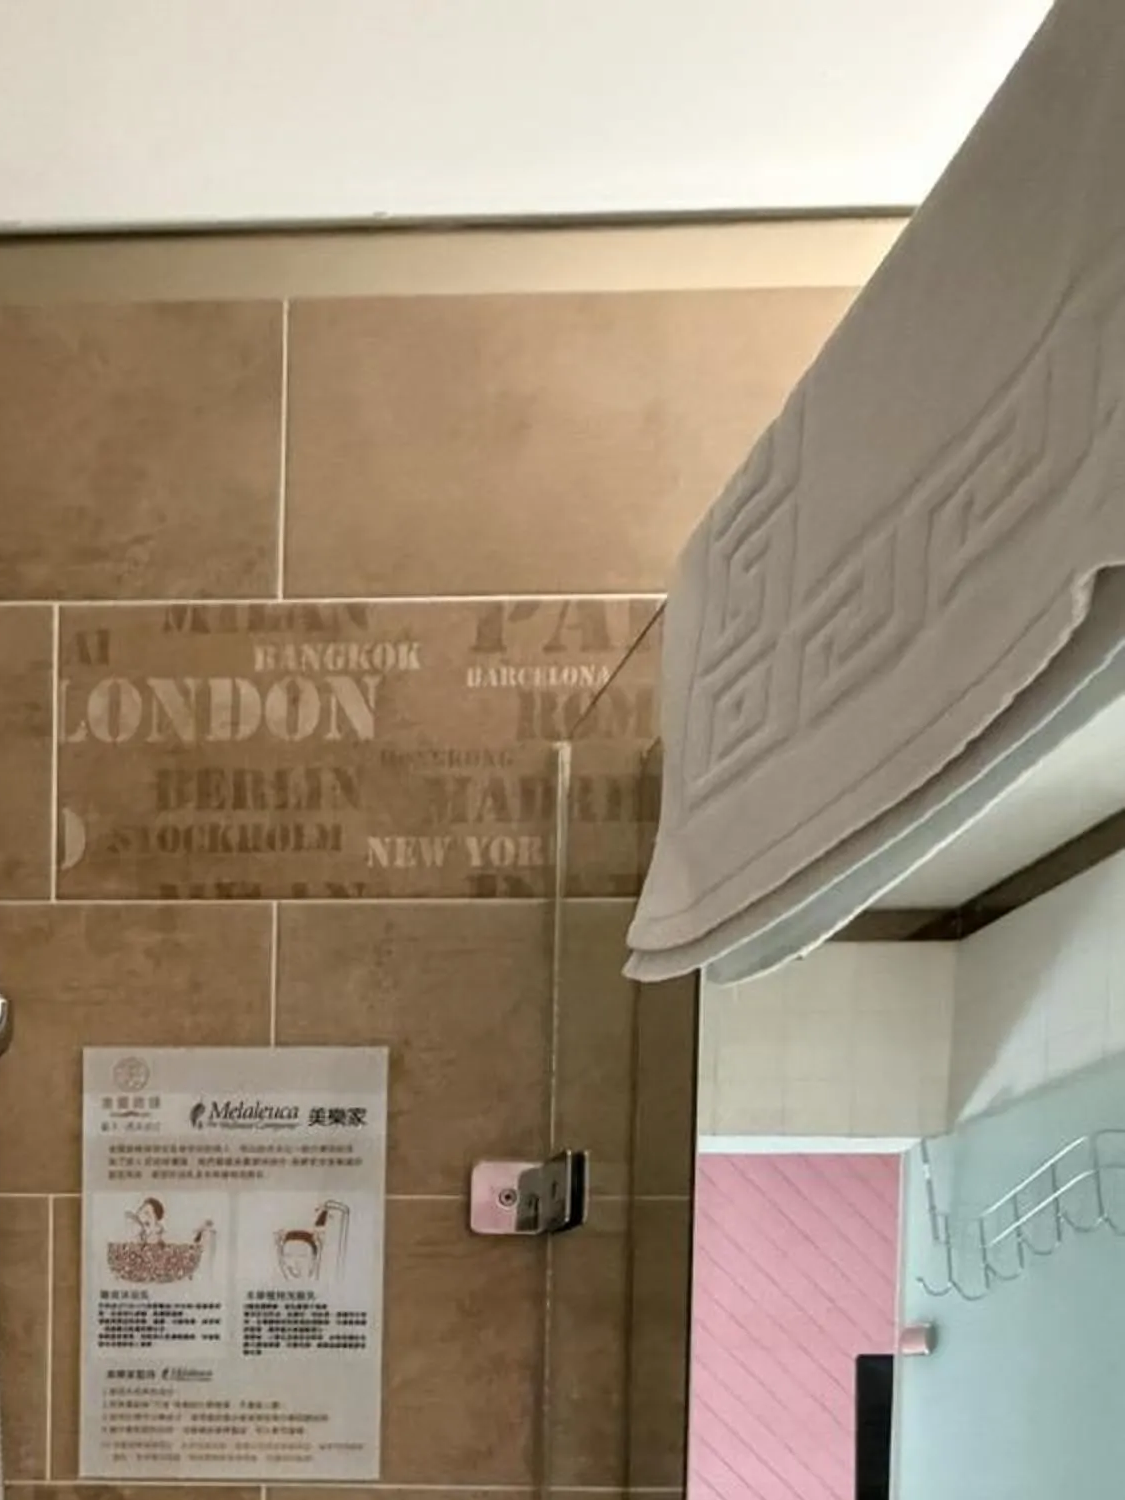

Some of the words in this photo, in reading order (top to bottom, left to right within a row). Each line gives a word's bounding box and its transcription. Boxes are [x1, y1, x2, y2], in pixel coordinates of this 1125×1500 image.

[254, 641, 421, 671] BANGKOK
[466, 665, 611, 688] BARCELONA
[59, 675, 383, 746] LONDON
[109, 823, 343, 853] STOCKHOLM
[366, 836, 452, 869] NEW
[207, 1100, 300, 1121] Melaleuca
